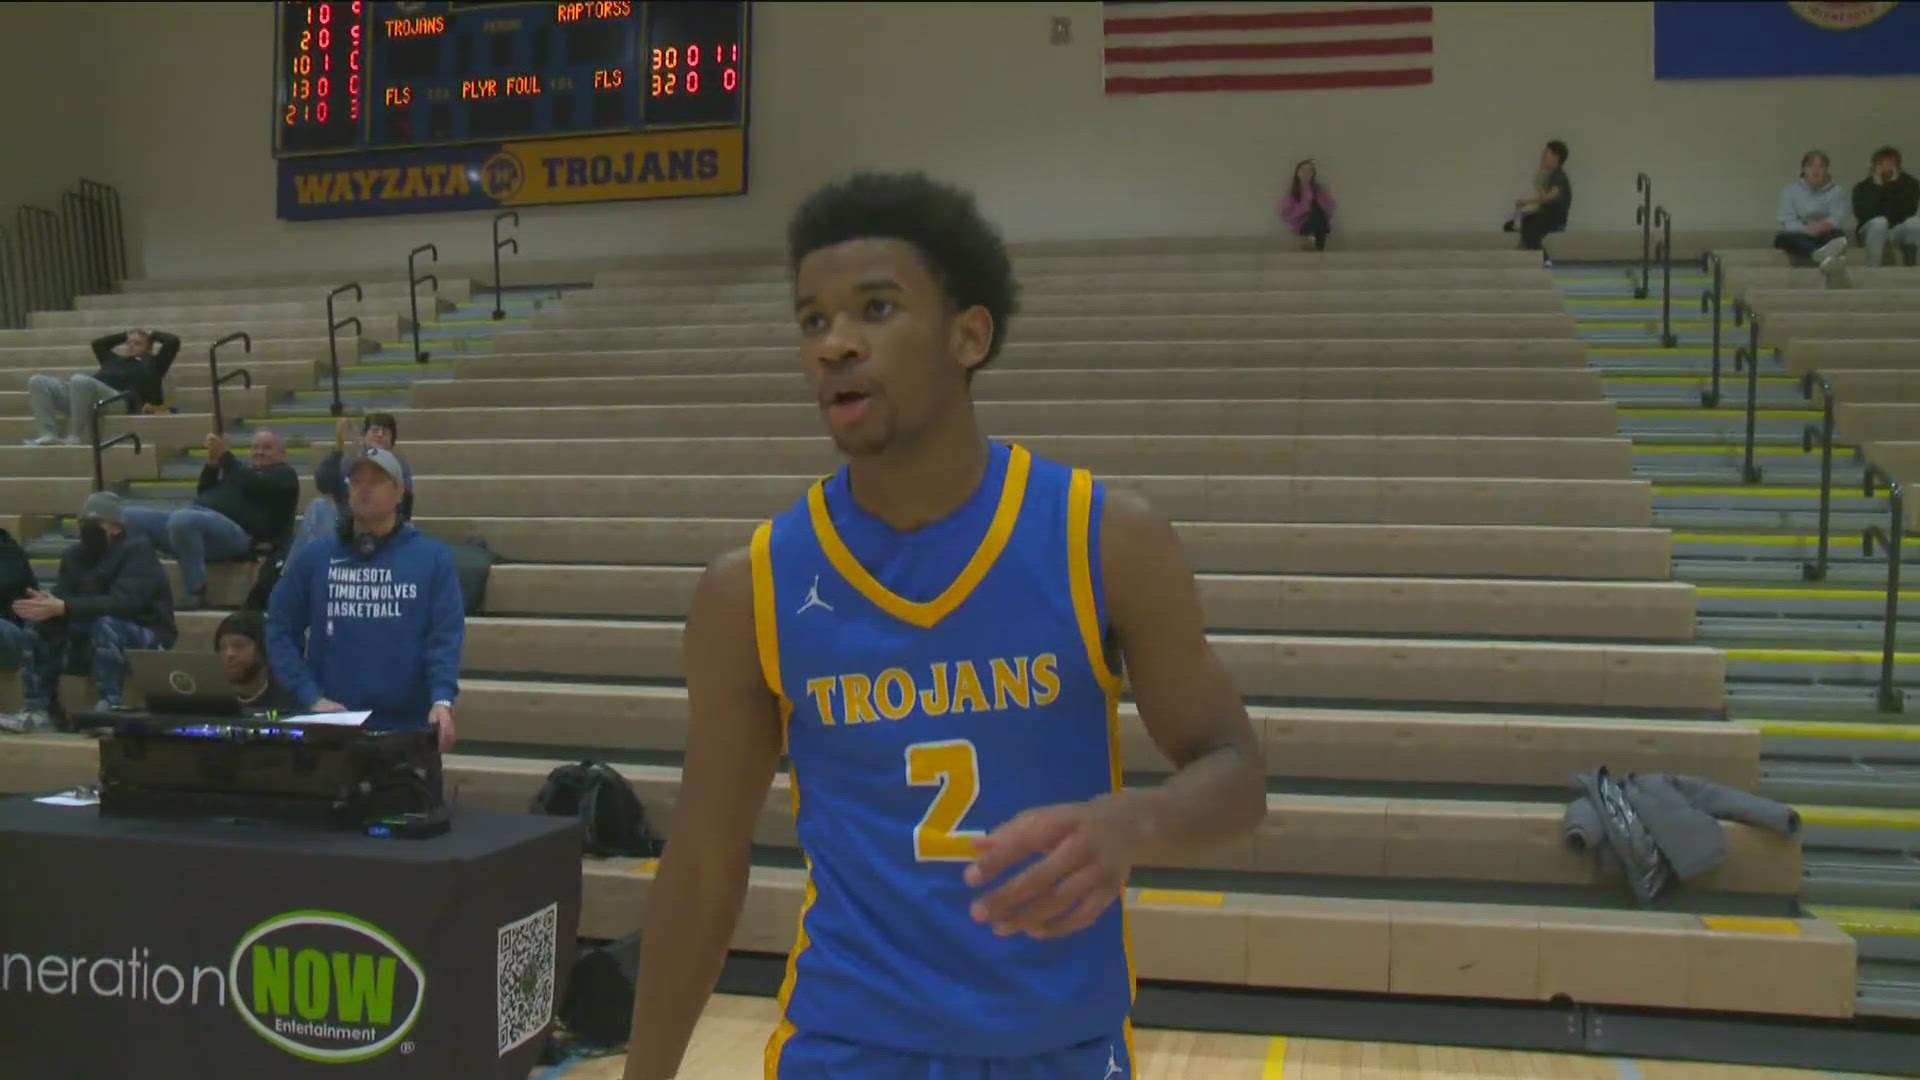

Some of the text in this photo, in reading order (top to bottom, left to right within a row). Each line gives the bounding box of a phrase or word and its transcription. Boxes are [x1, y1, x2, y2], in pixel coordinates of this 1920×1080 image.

[307, 7, 312, 24] 1
[319, 4, 331, 24] 0
[557, 1, 632, 23] RAPTORSS
[384, 16, 445, 38] TROJANS
[300, 30, 311, 50] 2
[318, 28, 330, 48] 0
[293, 55, 311, 75] 10
[324, 53, 329, 71] 1
[652, 43, 738, 71] 30 0 11
[292, 79, 310, 99] 13
[317, 77, 329, 97] 0
[385, 86, 412, 107] FLS
[461, 78, 498, 100] PLYR
[506, 75, 543, 97] FOUL
[593, 68, 624, 90] FLS
[651, 68, 737, 97] 32 0 0
[316, 102, 329, 122] 0
[293, 164, 471, 205] WAYZATA
[541, 149, 719, 188] TROJANS
[327, 566, 393, 583] MINNESOTA
[328, 583, 418, 600] TIMBERWOLVES
[326, 601, 402, 618] BASKETBALL
[806, 653, 1061, 726] TROJANS
[904, 738, 985, 862] 2
[252, 943, 398, 1027] NOW
[275, 1018, 377, 1042] Entertainment
